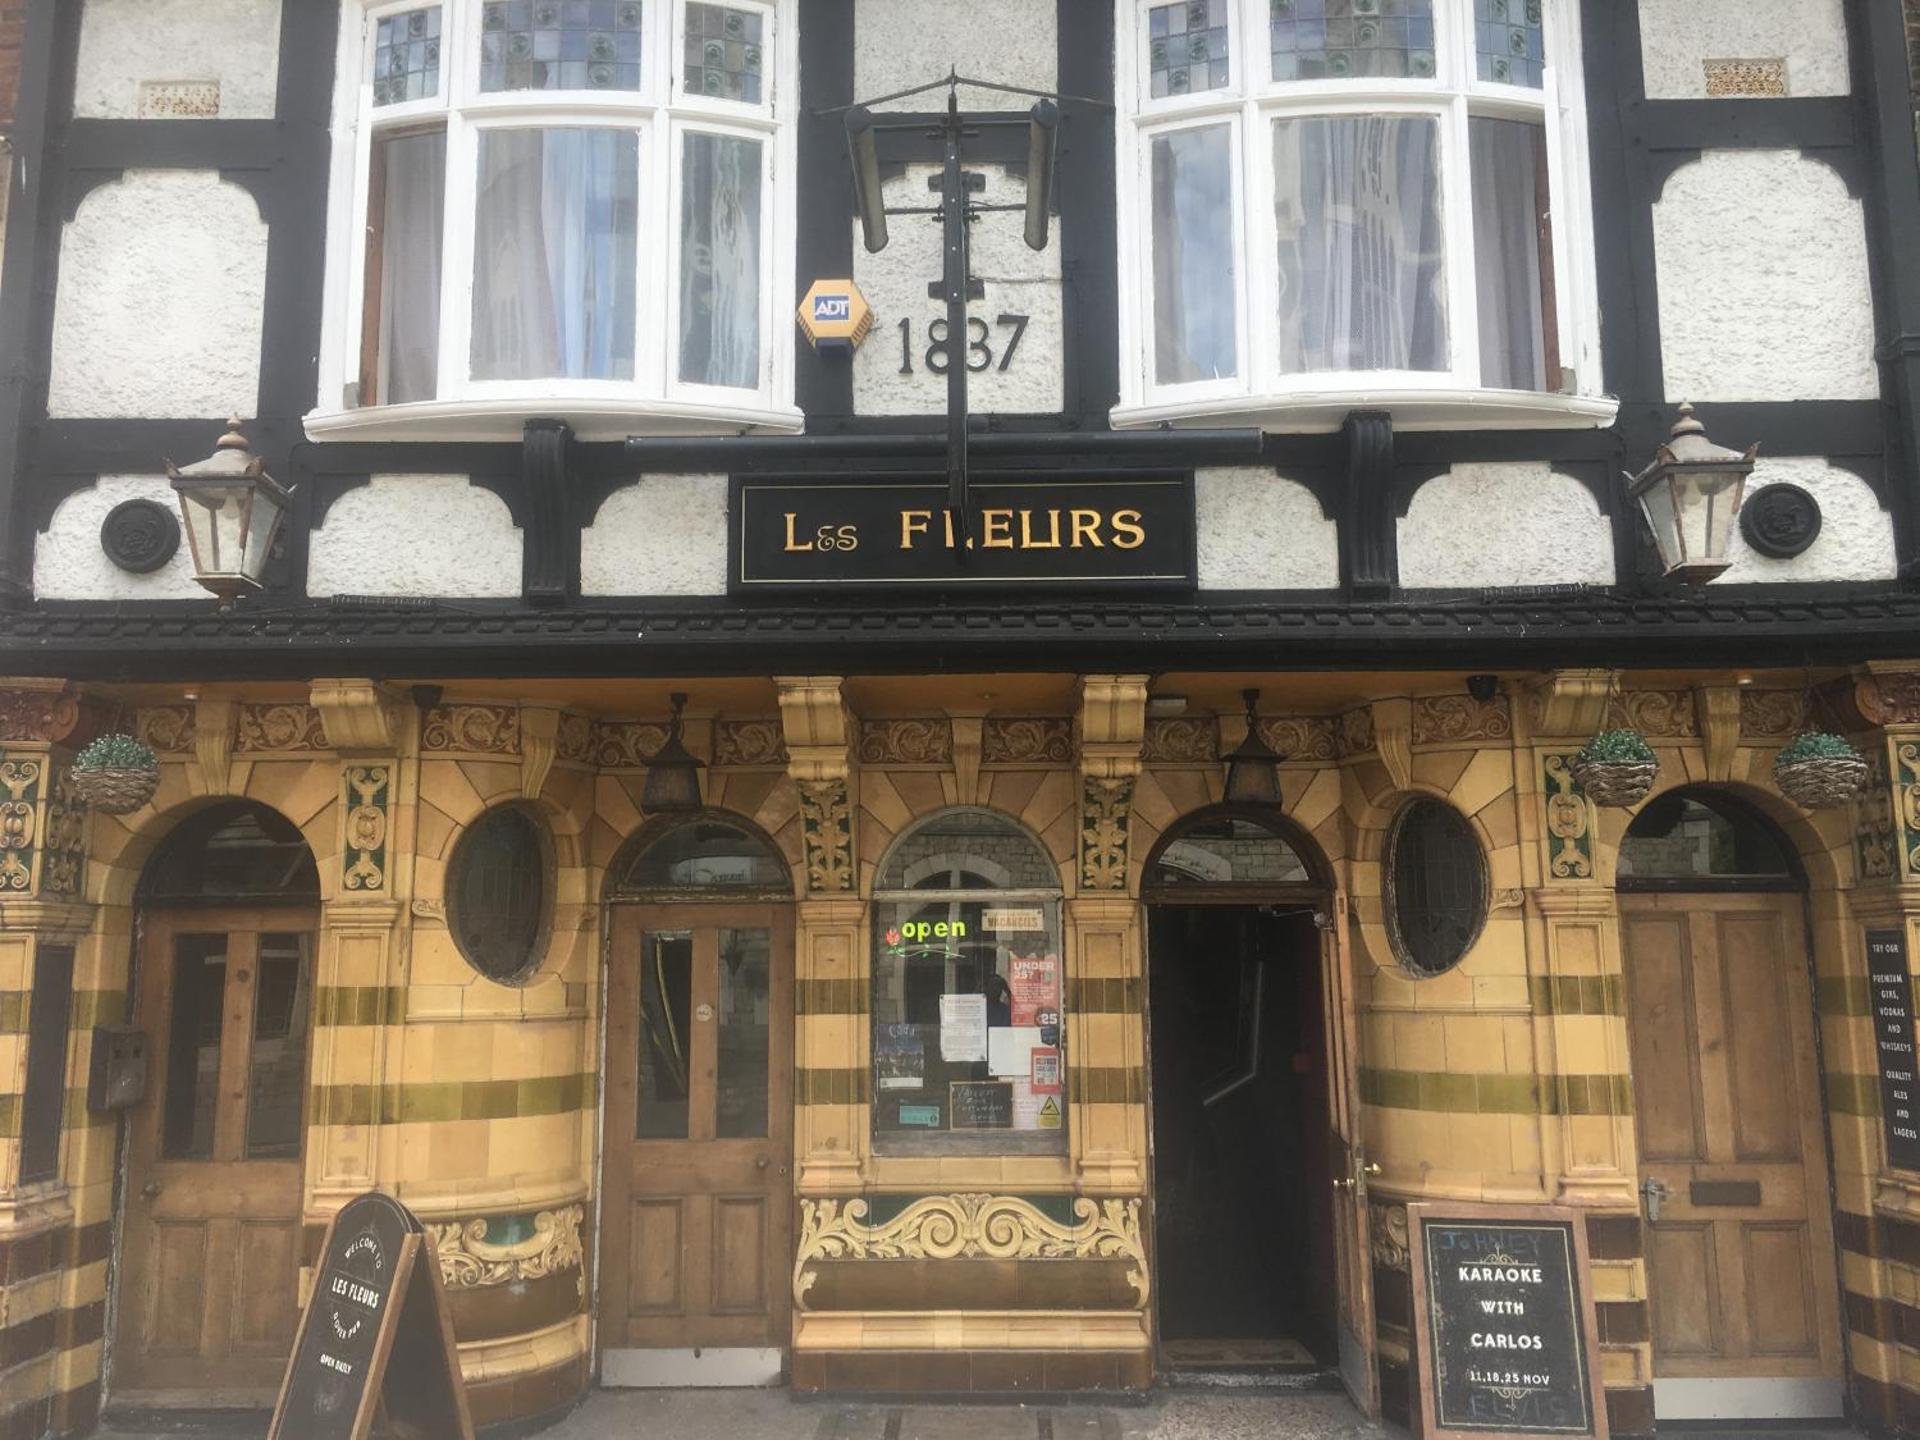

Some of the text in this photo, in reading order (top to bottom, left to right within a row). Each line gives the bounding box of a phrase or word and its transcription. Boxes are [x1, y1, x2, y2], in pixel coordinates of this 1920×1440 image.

[815, 300, 850, 316] ADT
[898, 314, 1031, 375] 1837
[901, 921, 966, 943] open
[1872, 943, 1899, 953] TRY OUR
[1013, 961, 1054, 971] UNDER
[1872, 973, 1903, 984] PREMIUM
[1879, 1007, 1905, 1017] VODKAS
[1887, 1024, 1902, 1034] AND
[1886, 1070, 1912, 1081] QUALITY
[1893, 1089, 1908, 1100] ALES
[1896, 1109, 1910, 1119] AND
[1893, 1126, 1917, 1140] LAGERS
[345, 1237, 377, 1259] WELCOME
[1458, 1267, 1543, 1283] KARAOKE
[332, 1276, 380, 1309] LES FLEURS
[1480, 1300, 1525, 1316] WITH
[1470, 1332, 1543, 1350] CARLOS
[320, 1353, 336, 1368] OPEN
[1523, 1373, 1550, 1386] NOV
